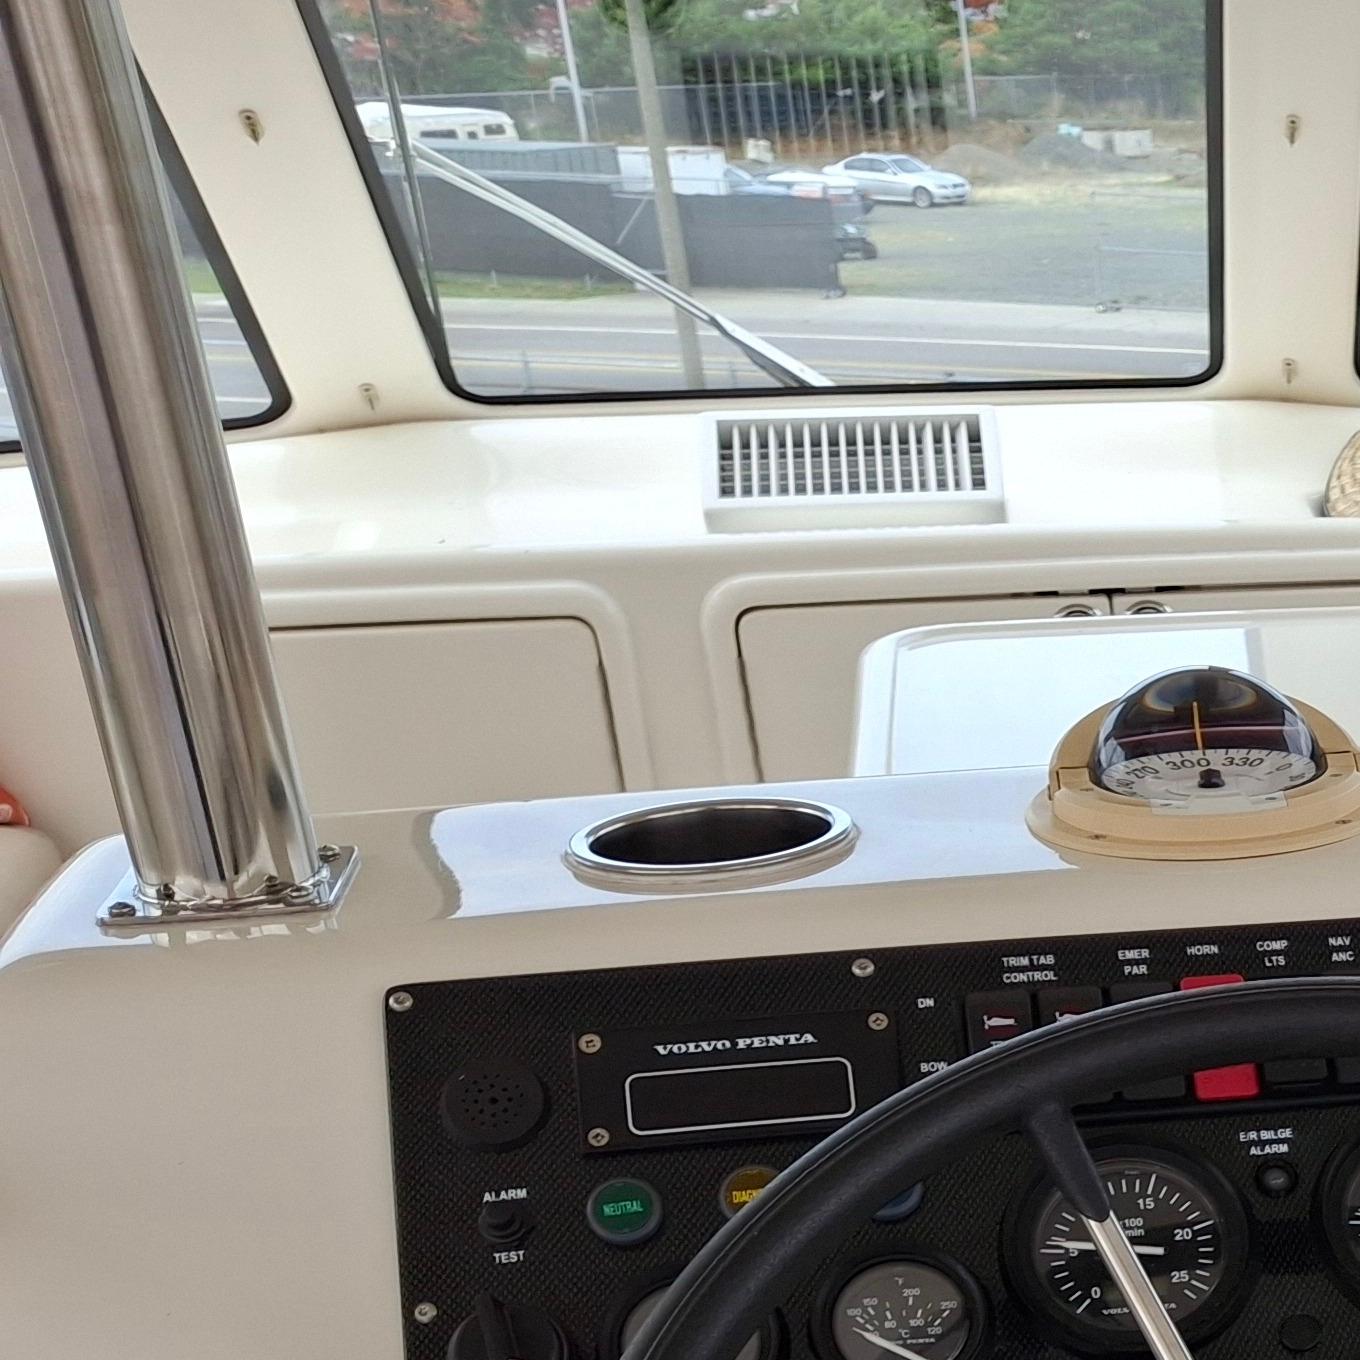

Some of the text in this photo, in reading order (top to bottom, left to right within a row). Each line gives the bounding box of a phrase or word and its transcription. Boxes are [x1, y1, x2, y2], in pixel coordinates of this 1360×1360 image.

[1165, 757, 1211, 771] 300
[1221, 756, 1265, 768] 330
[1126, 766, 1160, 780] 270
[1256, 940, 1288, 951] COMP
[1328, 936, 1351, 947] NAV
[1117, 949, 1150, 961] EMER
[1186, 944, 1219, 956] HORN
[1002, 954, 1056, 968] TRIM TAB
[1265, 955, 1286, 967] LTS
[1331, 951, 1355, 963] ANC
[1124, 964, 1148, 976] PAR
[1003, 970, 1057, 983] CONTROL
[917, 998, 934, 1009] DN
[654, 1033, 818, 1056] VOLVO PENTA
[920, 1060, 949, 1073] BOW
[1239, 1127, 1293, 1142] E/R BILGE
[1249, 1142, 1289, 1155] ALARM
[482, 1188, 528, 1203] ALARM
[602, 1200, 644, 1216] NEUTRAL
[1137, 1197, 1155, 1210] 15
[1174, 1229, 1192, 1241] 20
[493, 1250, 526, 1265] TEST
[1171, 1271, 1190, 1283] 25
[902, 1288, 920, 1297] 200
[1091, 1286, 1101, 1299] 0
[909, 1319, 924, 1327] 100
[927, 1327, 942, 1335] 120
